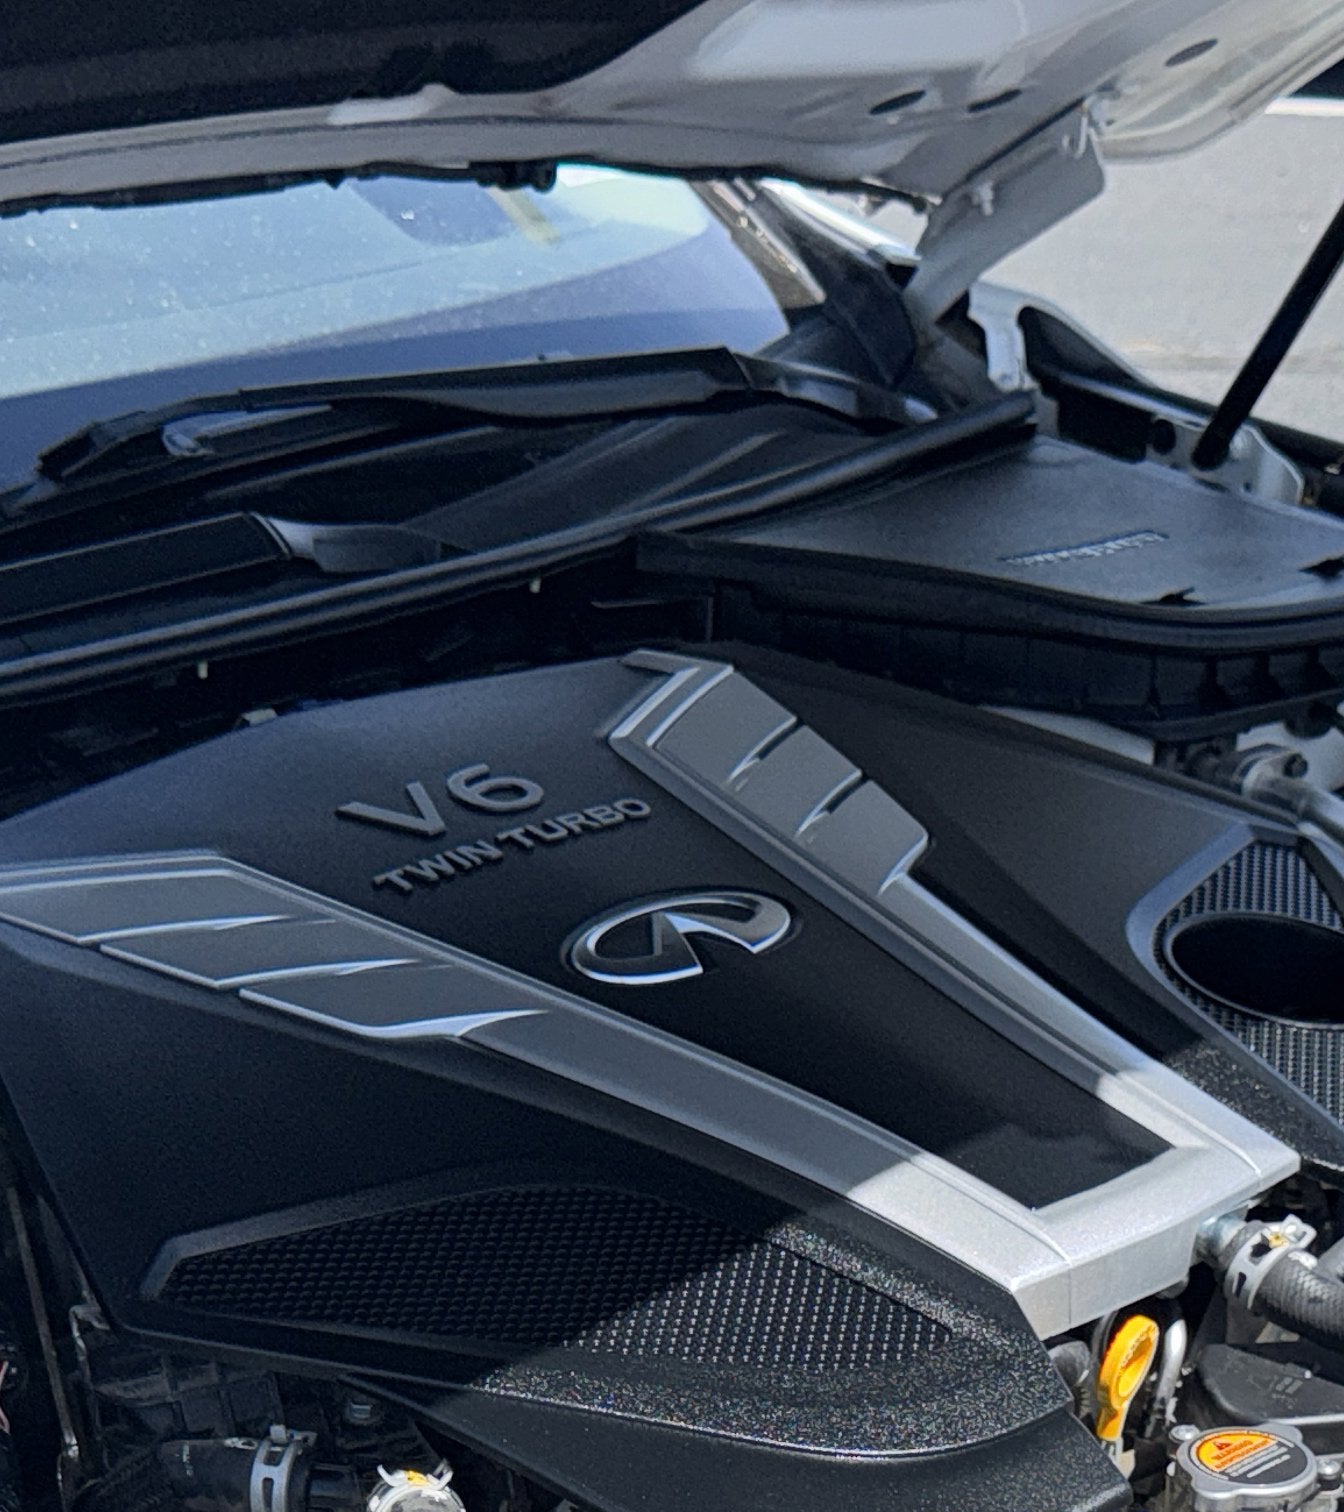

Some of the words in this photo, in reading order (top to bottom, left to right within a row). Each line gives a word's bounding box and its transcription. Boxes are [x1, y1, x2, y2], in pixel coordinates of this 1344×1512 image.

[334, 762, 545, 837] V6
[372, 840, 504, 893] TWIN
[494, 797, 652, 849] TURBO
